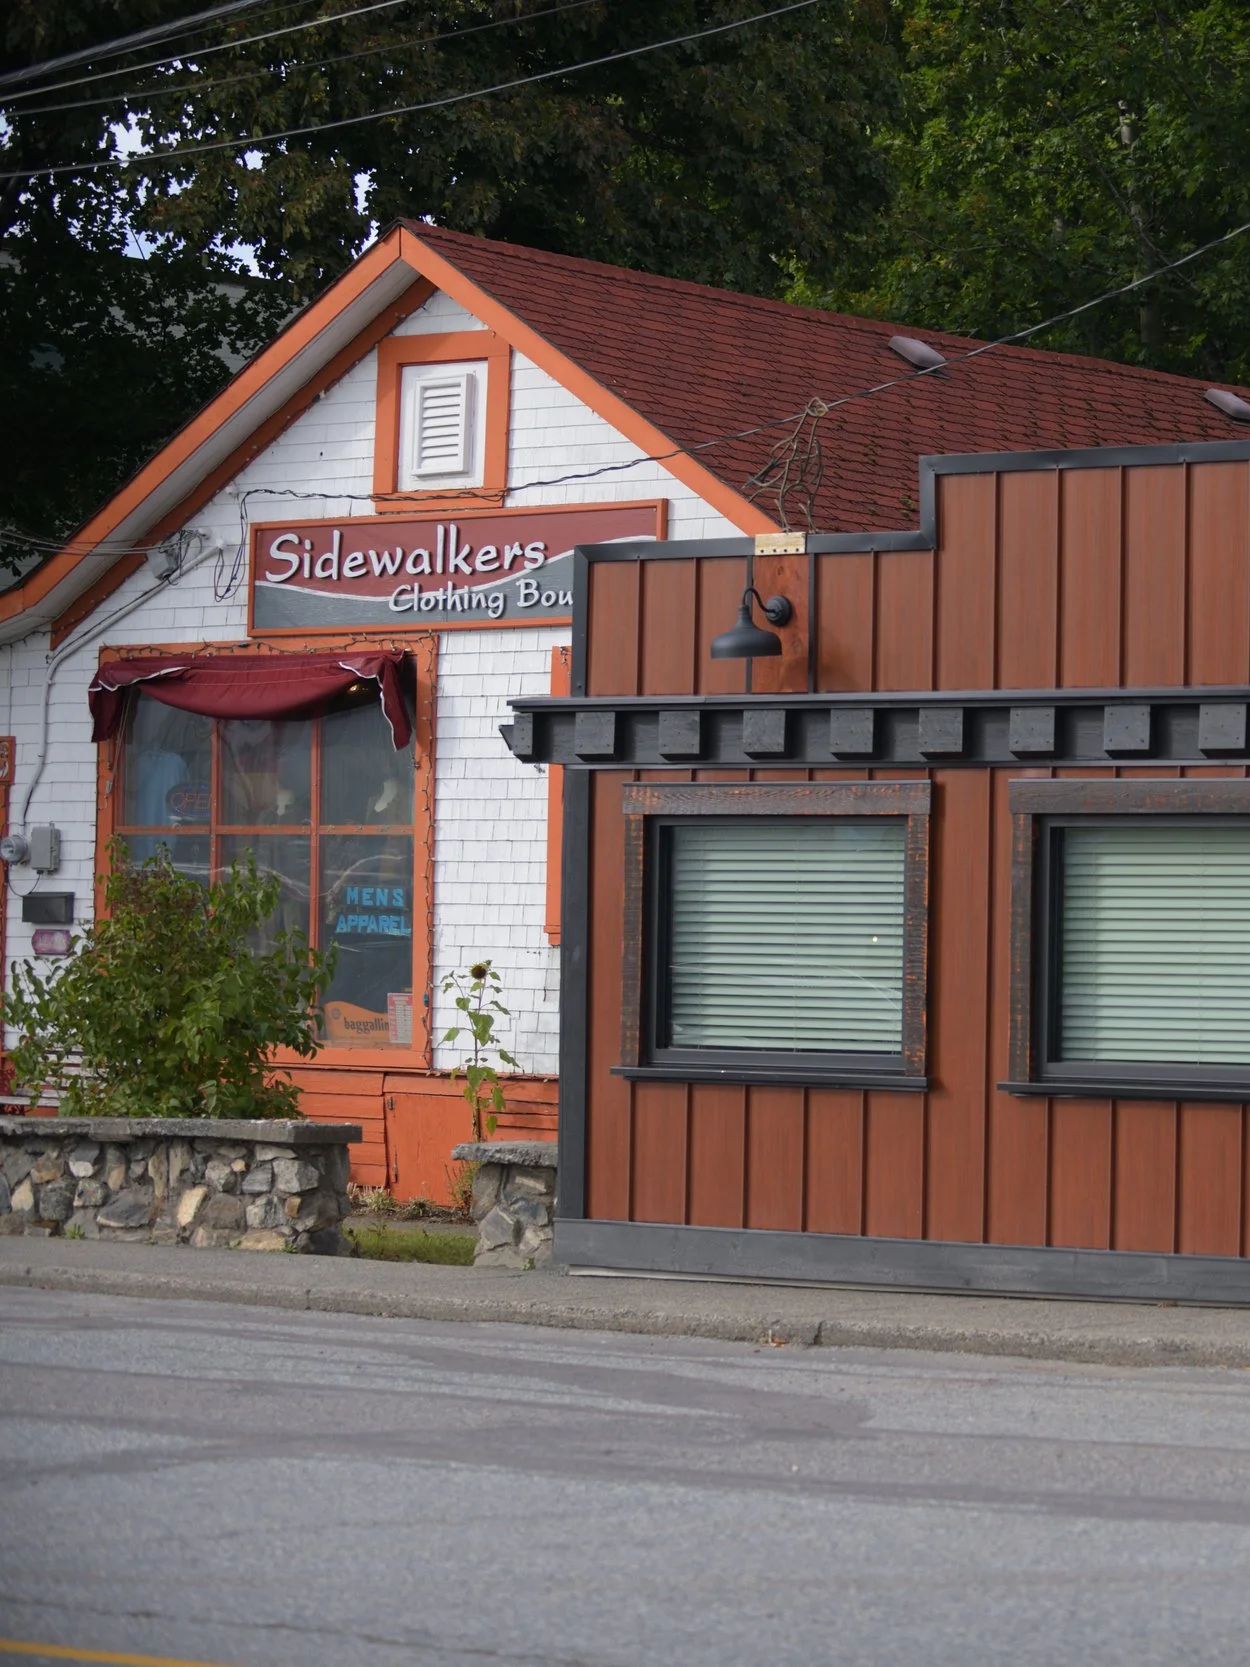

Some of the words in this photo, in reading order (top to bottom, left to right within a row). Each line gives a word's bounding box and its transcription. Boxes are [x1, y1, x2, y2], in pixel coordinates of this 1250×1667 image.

[265, 524, 546, 583] Sidewalkers
[388, 582, 504, 618] Clothing
[170, 792, 212, 809] OPE
[346, 887, 404, 907] MENS
[335, 914, 412, 936] APPAREL
